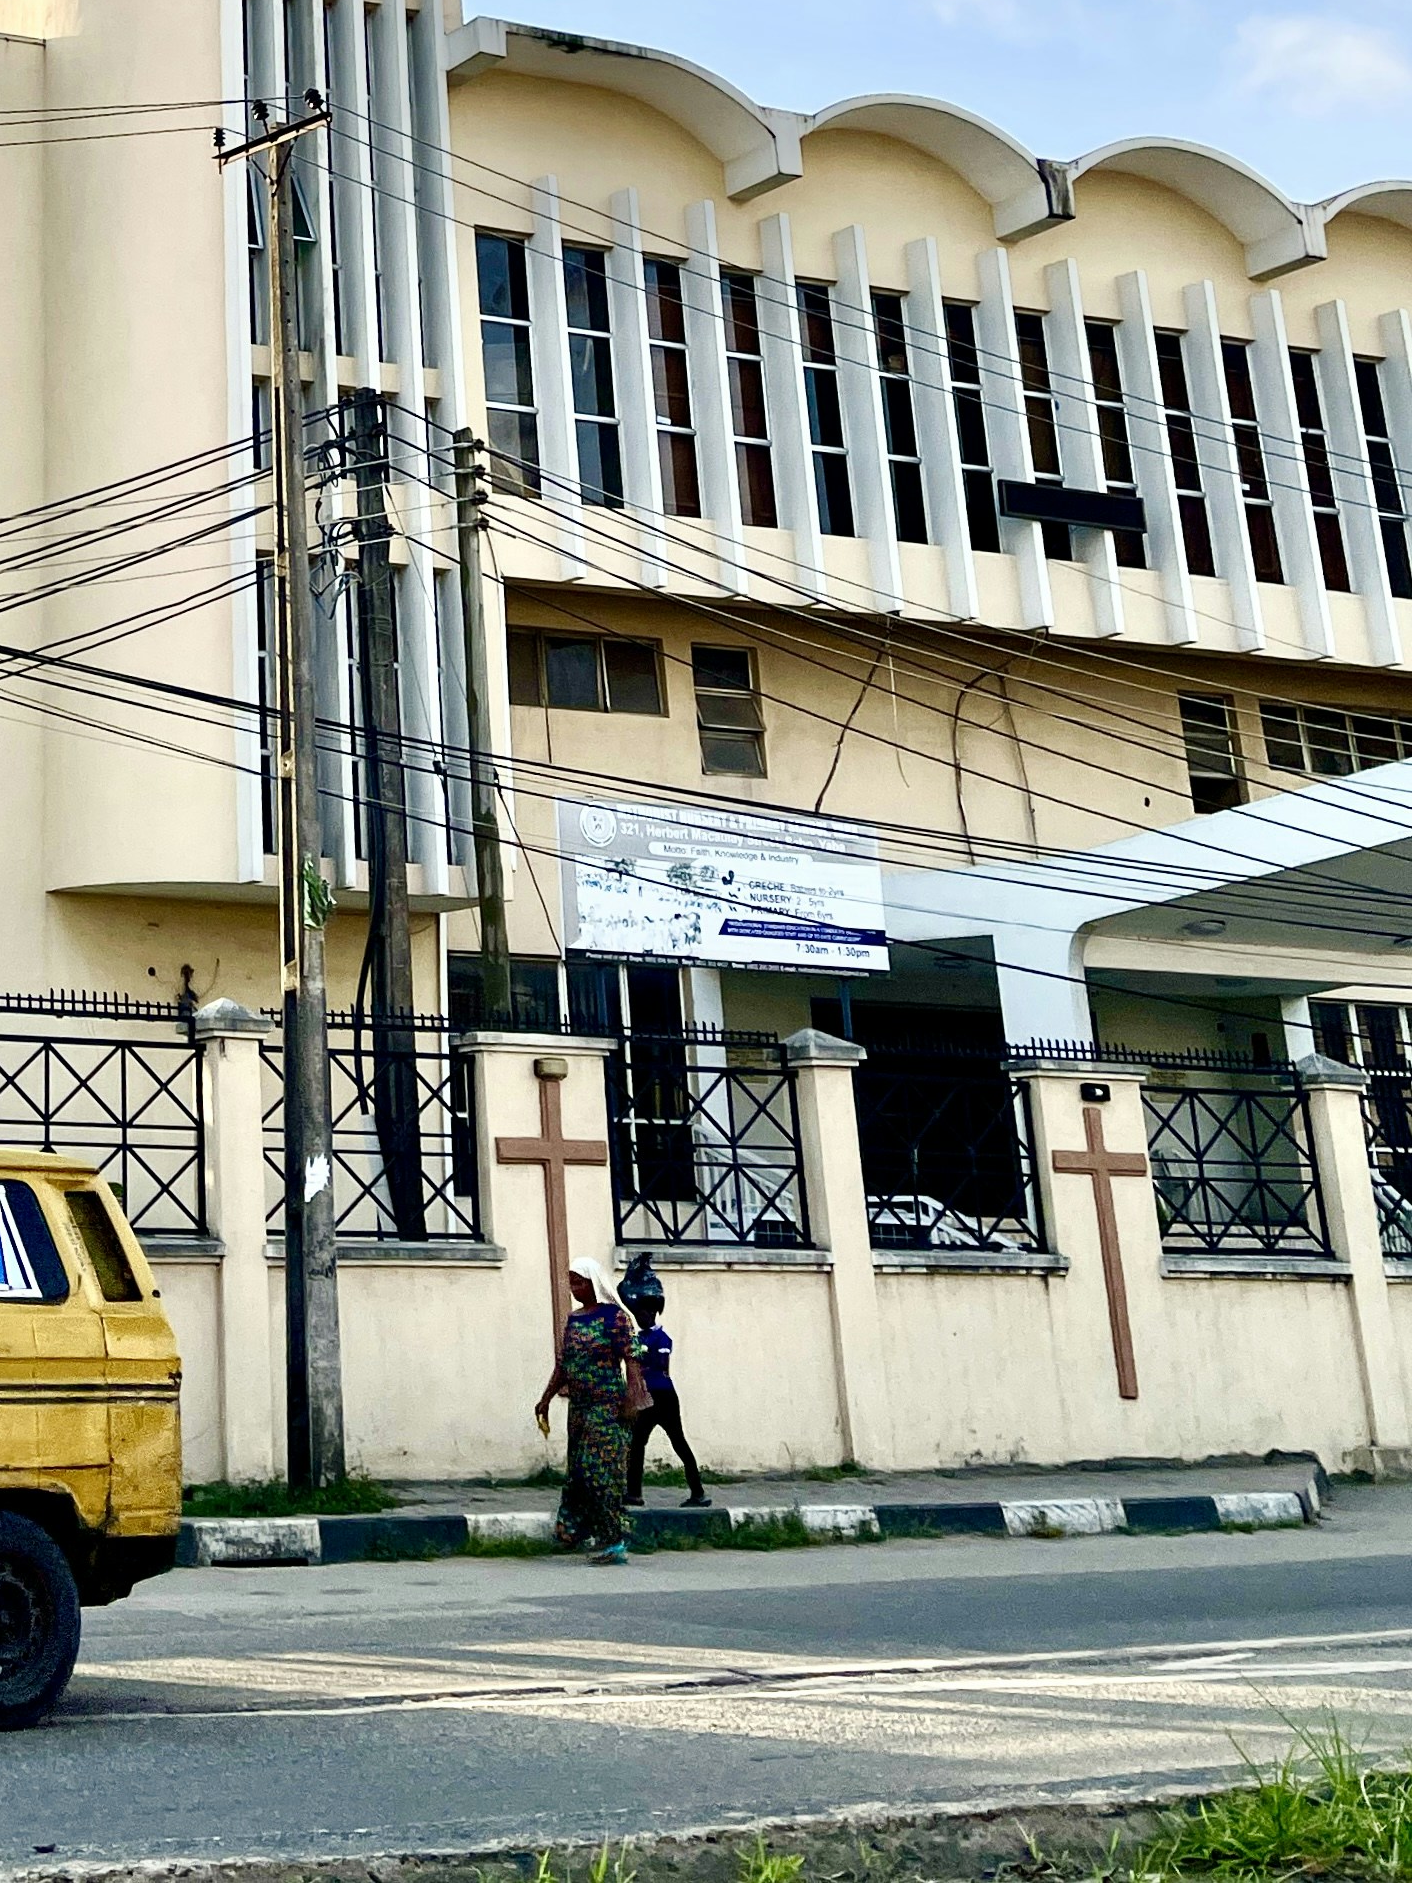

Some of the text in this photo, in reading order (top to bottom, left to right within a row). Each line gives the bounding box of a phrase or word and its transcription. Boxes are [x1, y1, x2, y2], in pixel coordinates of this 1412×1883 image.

[620, 822, 644, 838] 321,
[645, 824, 689, 840] Herbert
[690, 827, 744, 847] Macaulay
[715, 849, 758, 861] Knowledge
[760, 852, 767, 861] &
[769, 853, 799, 865] Industry
